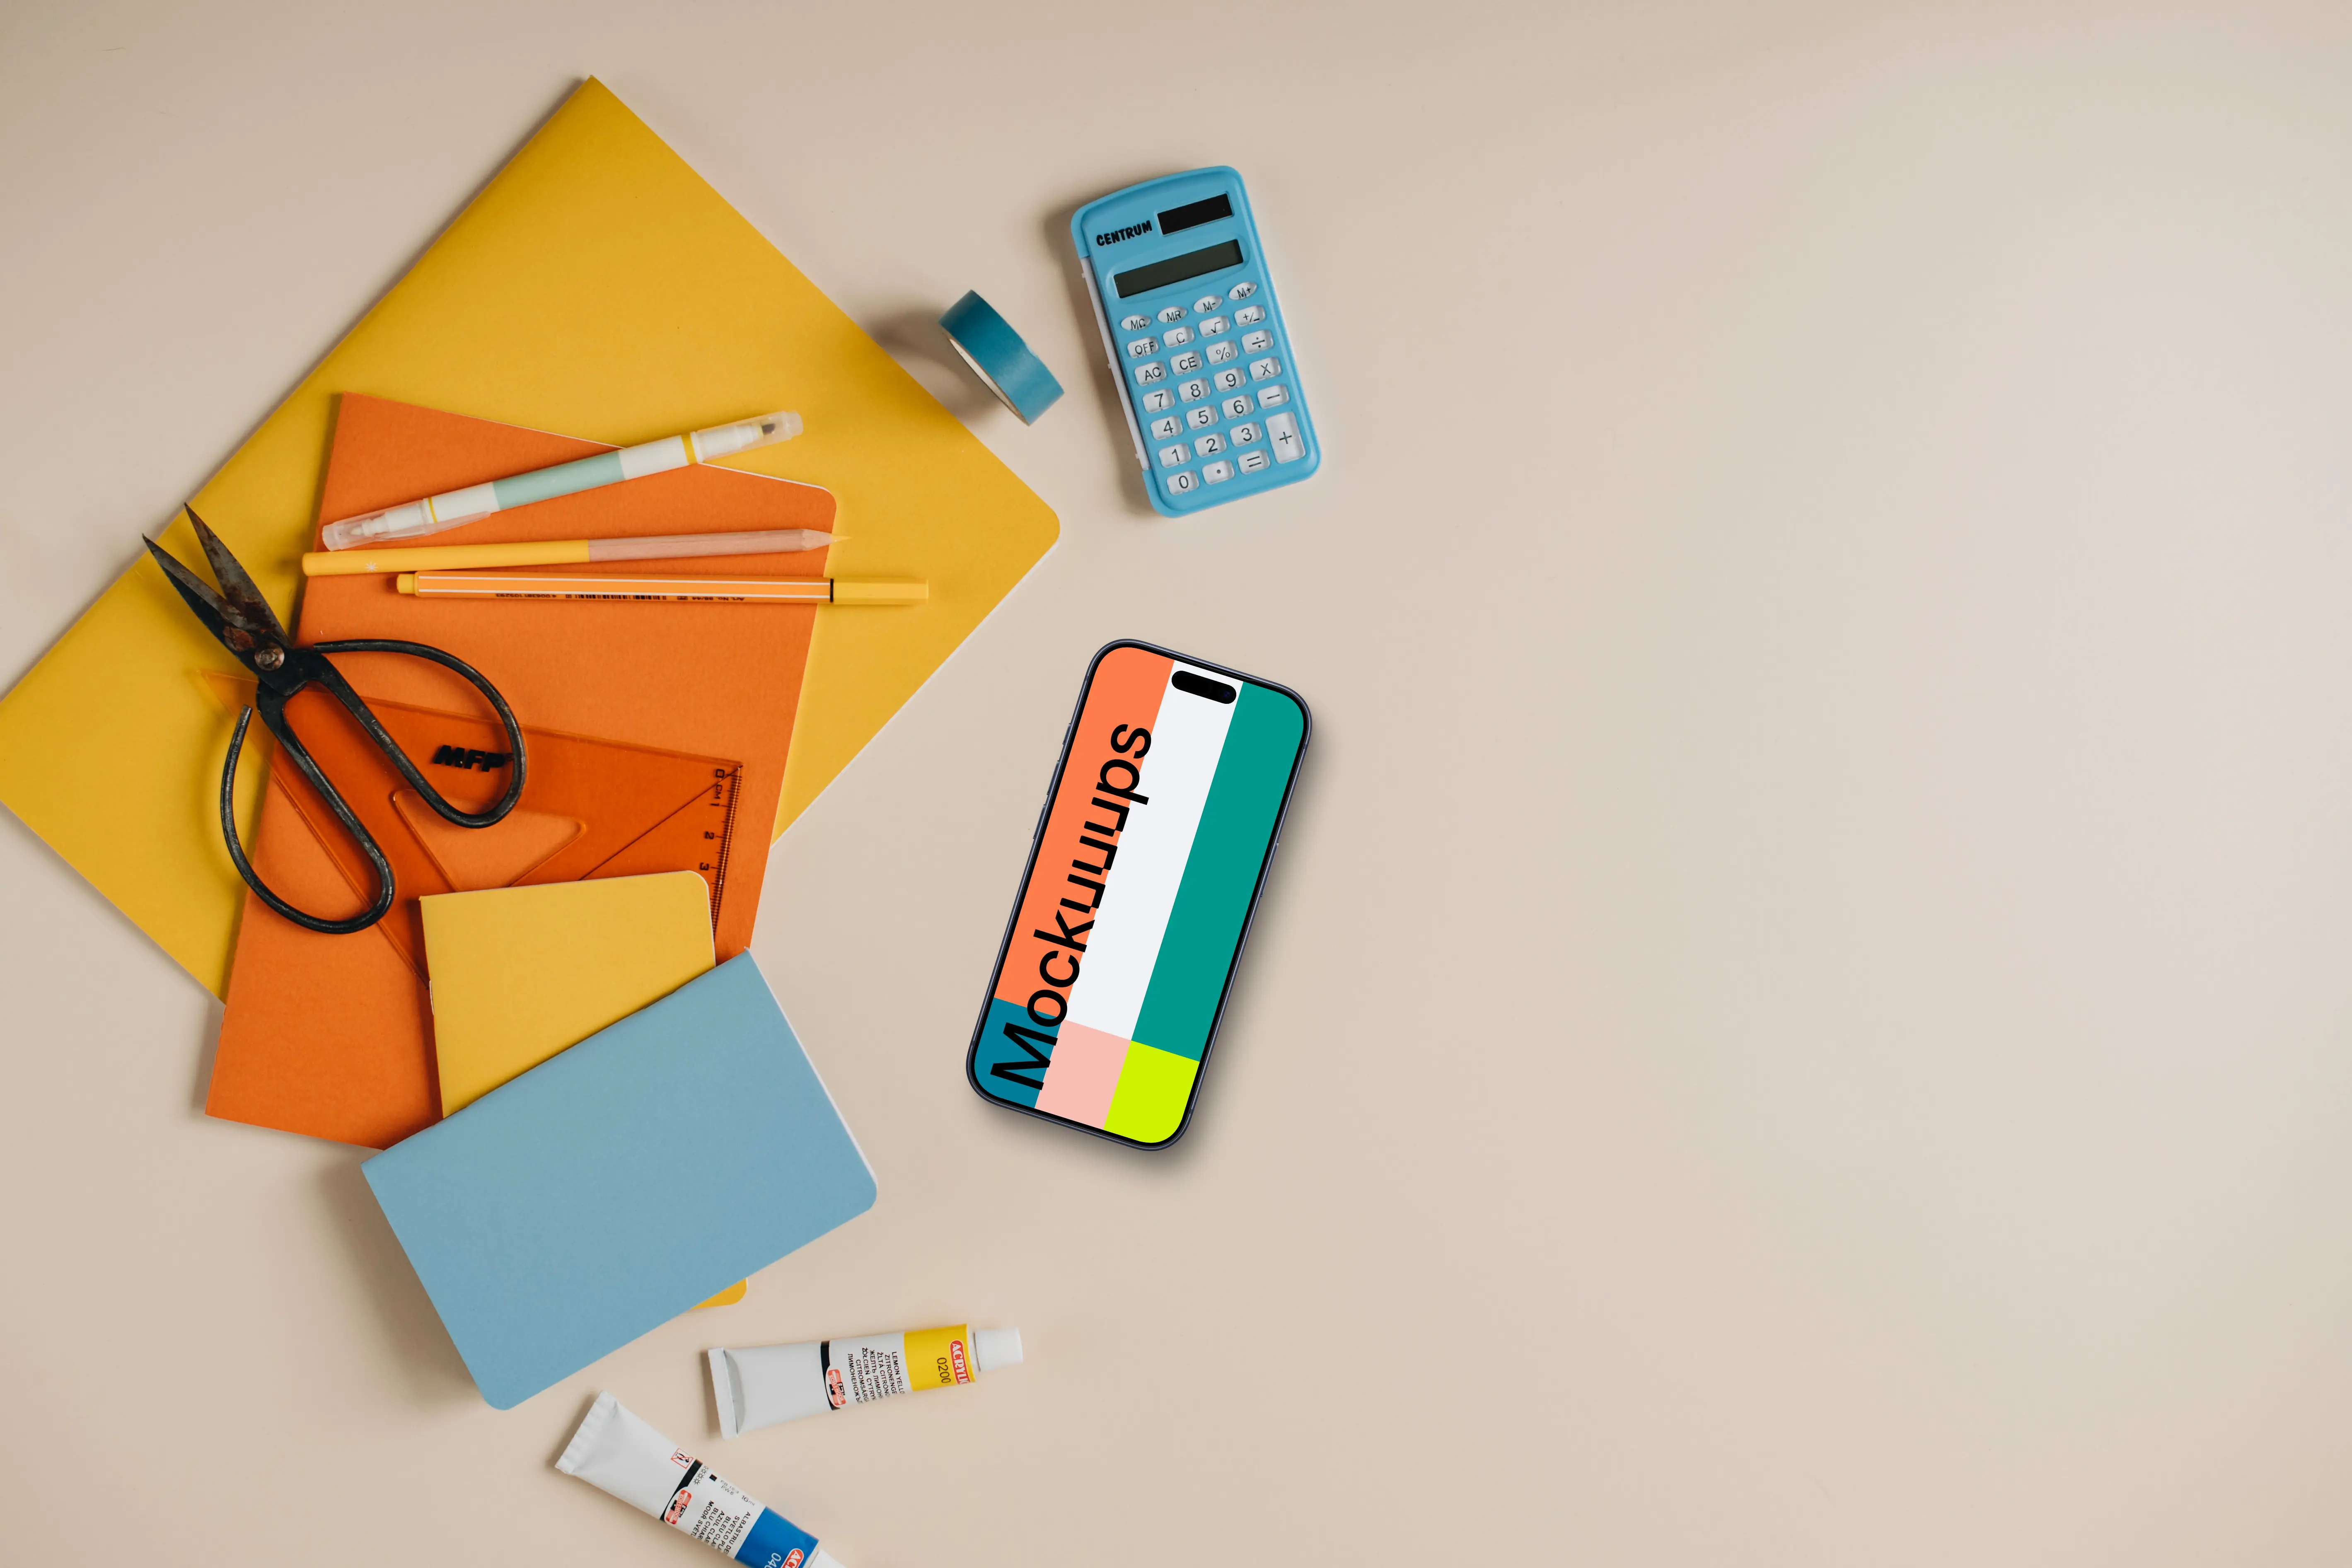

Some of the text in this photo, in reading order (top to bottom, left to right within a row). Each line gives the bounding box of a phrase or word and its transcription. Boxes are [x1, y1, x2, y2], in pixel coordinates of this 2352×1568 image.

[1096, 220, 1153, 246] CENTRUM
[1131, 318, 1146, 330] MC
[1166, 310, 1182, 322] MR
[1237, 287, 1251, 298] M+
[1134, 341, 1155, 355] OFF
[1176, 333, 1185, 344] C
[1145, 367, 1162, 380] AC
[1180, 356, 1197, 370] CE
[1154, 393, 1163, 408] 7
[1190, 384, 1201, 398] 8
[1226, 373, 1236, 387] 9
[1163, 420, 1174, 433] 4
[1198, 410, 1209, 424] 5
[1233, 400, 1244, 414] 6
[1172, 449, 1180, 462] 1
[1206, 438, 1218, 453] 2
[1241, 428, 1252, 442] 3
[1178, 475, 1189, 489] 0
[434, 745, 507, 772] MFP
[715, 768, 725, 778] 0
[714, 784, 723, 800] CM
[704, 831, 715, 840] 2
[699, 862, 709, 871] 3
[991, 724, 1151, 1090] Mockuuups
[937, 1358, 951, 1383] 0200
[701, 1501, 714, 1519] MODŘ
[709, 1508, 718, 1521] BLU
[703, 1510, 724, 1545] AZUL CLAR
[719, 1516, 731, 1533] BLEU
[723, 1516, 740, 1539] SVETLO
[729, 1512, 750, 1544] ALBASTRU
